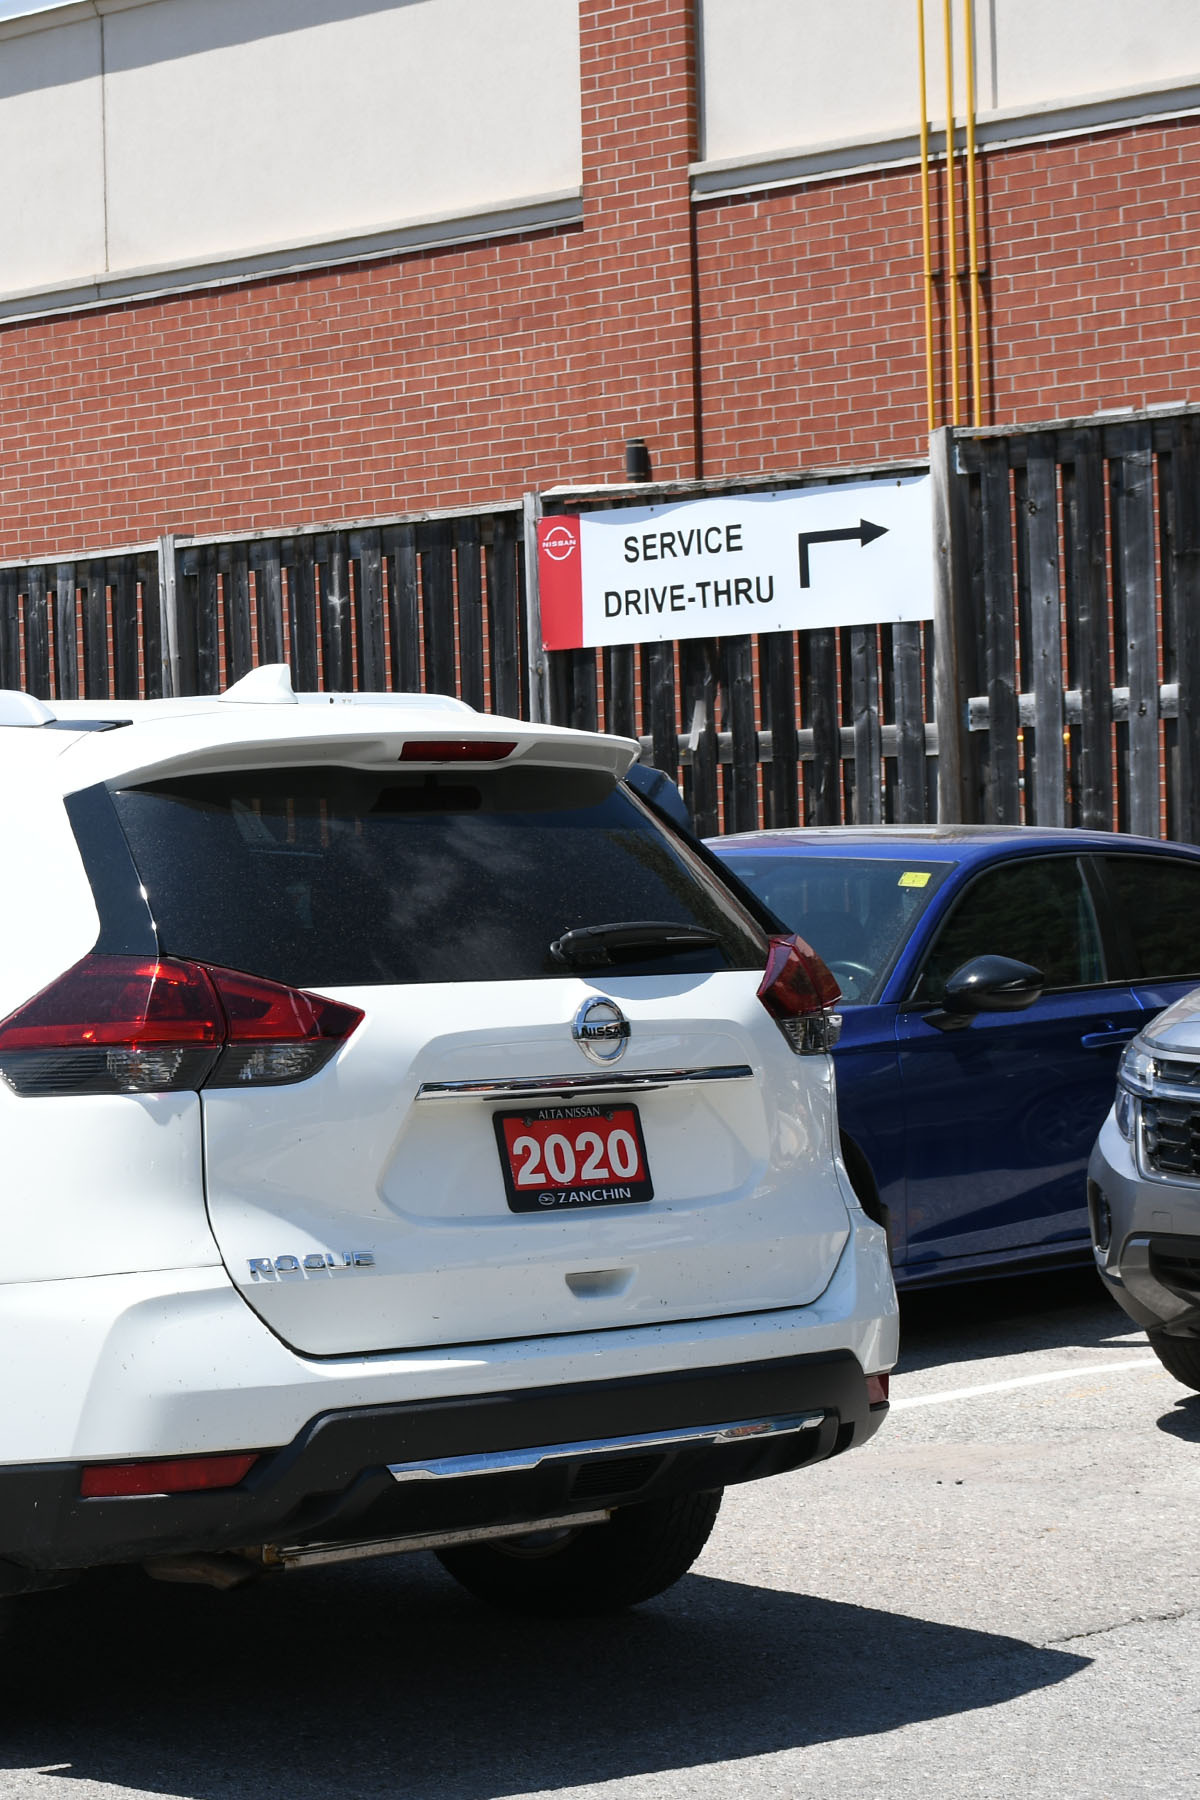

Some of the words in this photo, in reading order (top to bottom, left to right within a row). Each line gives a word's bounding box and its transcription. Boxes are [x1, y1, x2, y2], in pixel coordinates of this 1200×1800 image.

[542, 539, 576, 548] NISSAN
[623, 523, 743, 563] SERVICE
[604, 575, 775, 618] DRIVE-THRU
[564, 1106, 600, 1119] NISSAN
[513, 1129, 639, 1185] 2020
[557, 1187, 631, 1204] ZANCHIN
[247, 1250, 377, 1275] ROGUE
